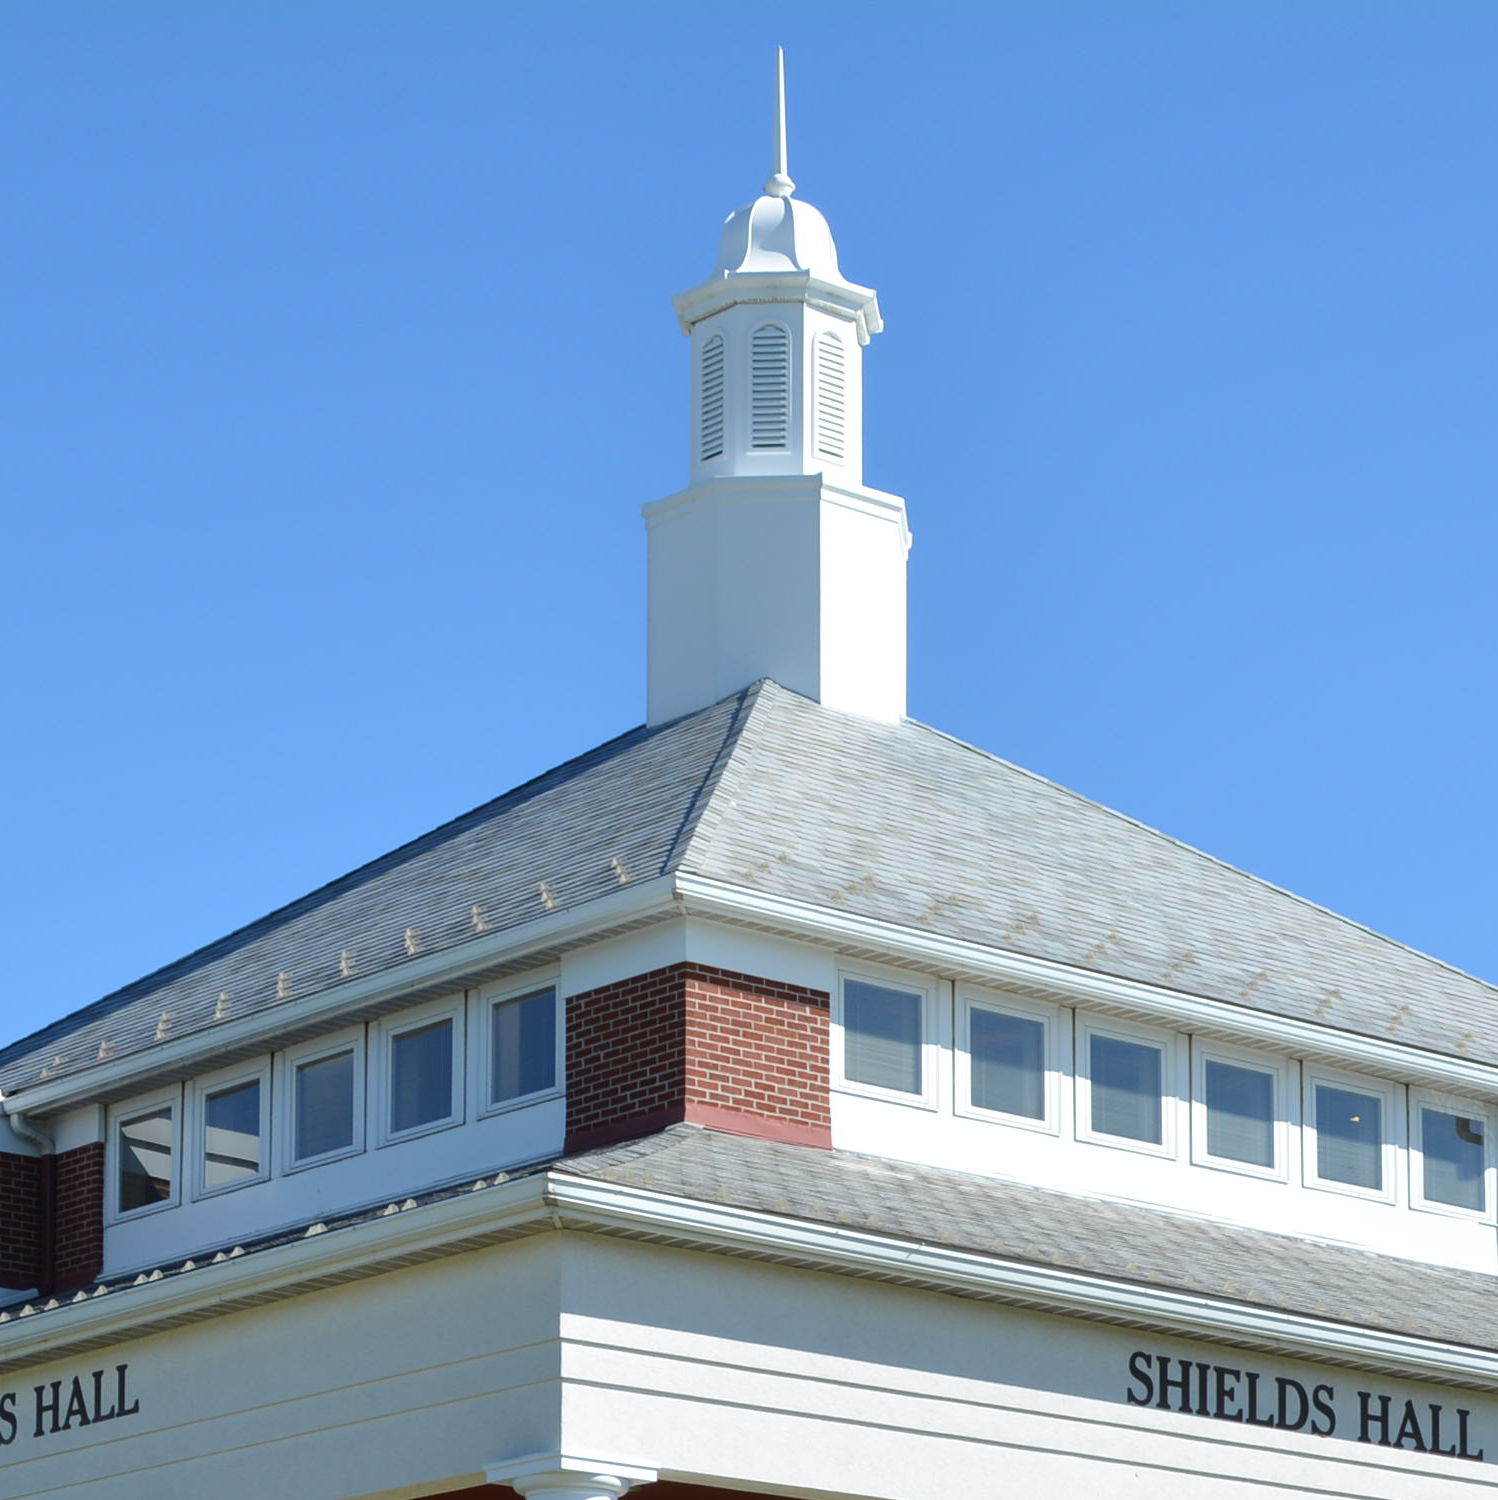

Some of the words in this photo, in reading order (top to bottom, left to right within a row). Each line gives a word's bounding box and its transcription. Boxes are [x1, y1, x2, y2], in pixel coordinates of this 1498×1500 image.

[33, 1363, 140, 1438] HALL
[1127, 1351, 1336, 1437] SHIELDS
[1357, 1390, 1484, 1462] HALL
